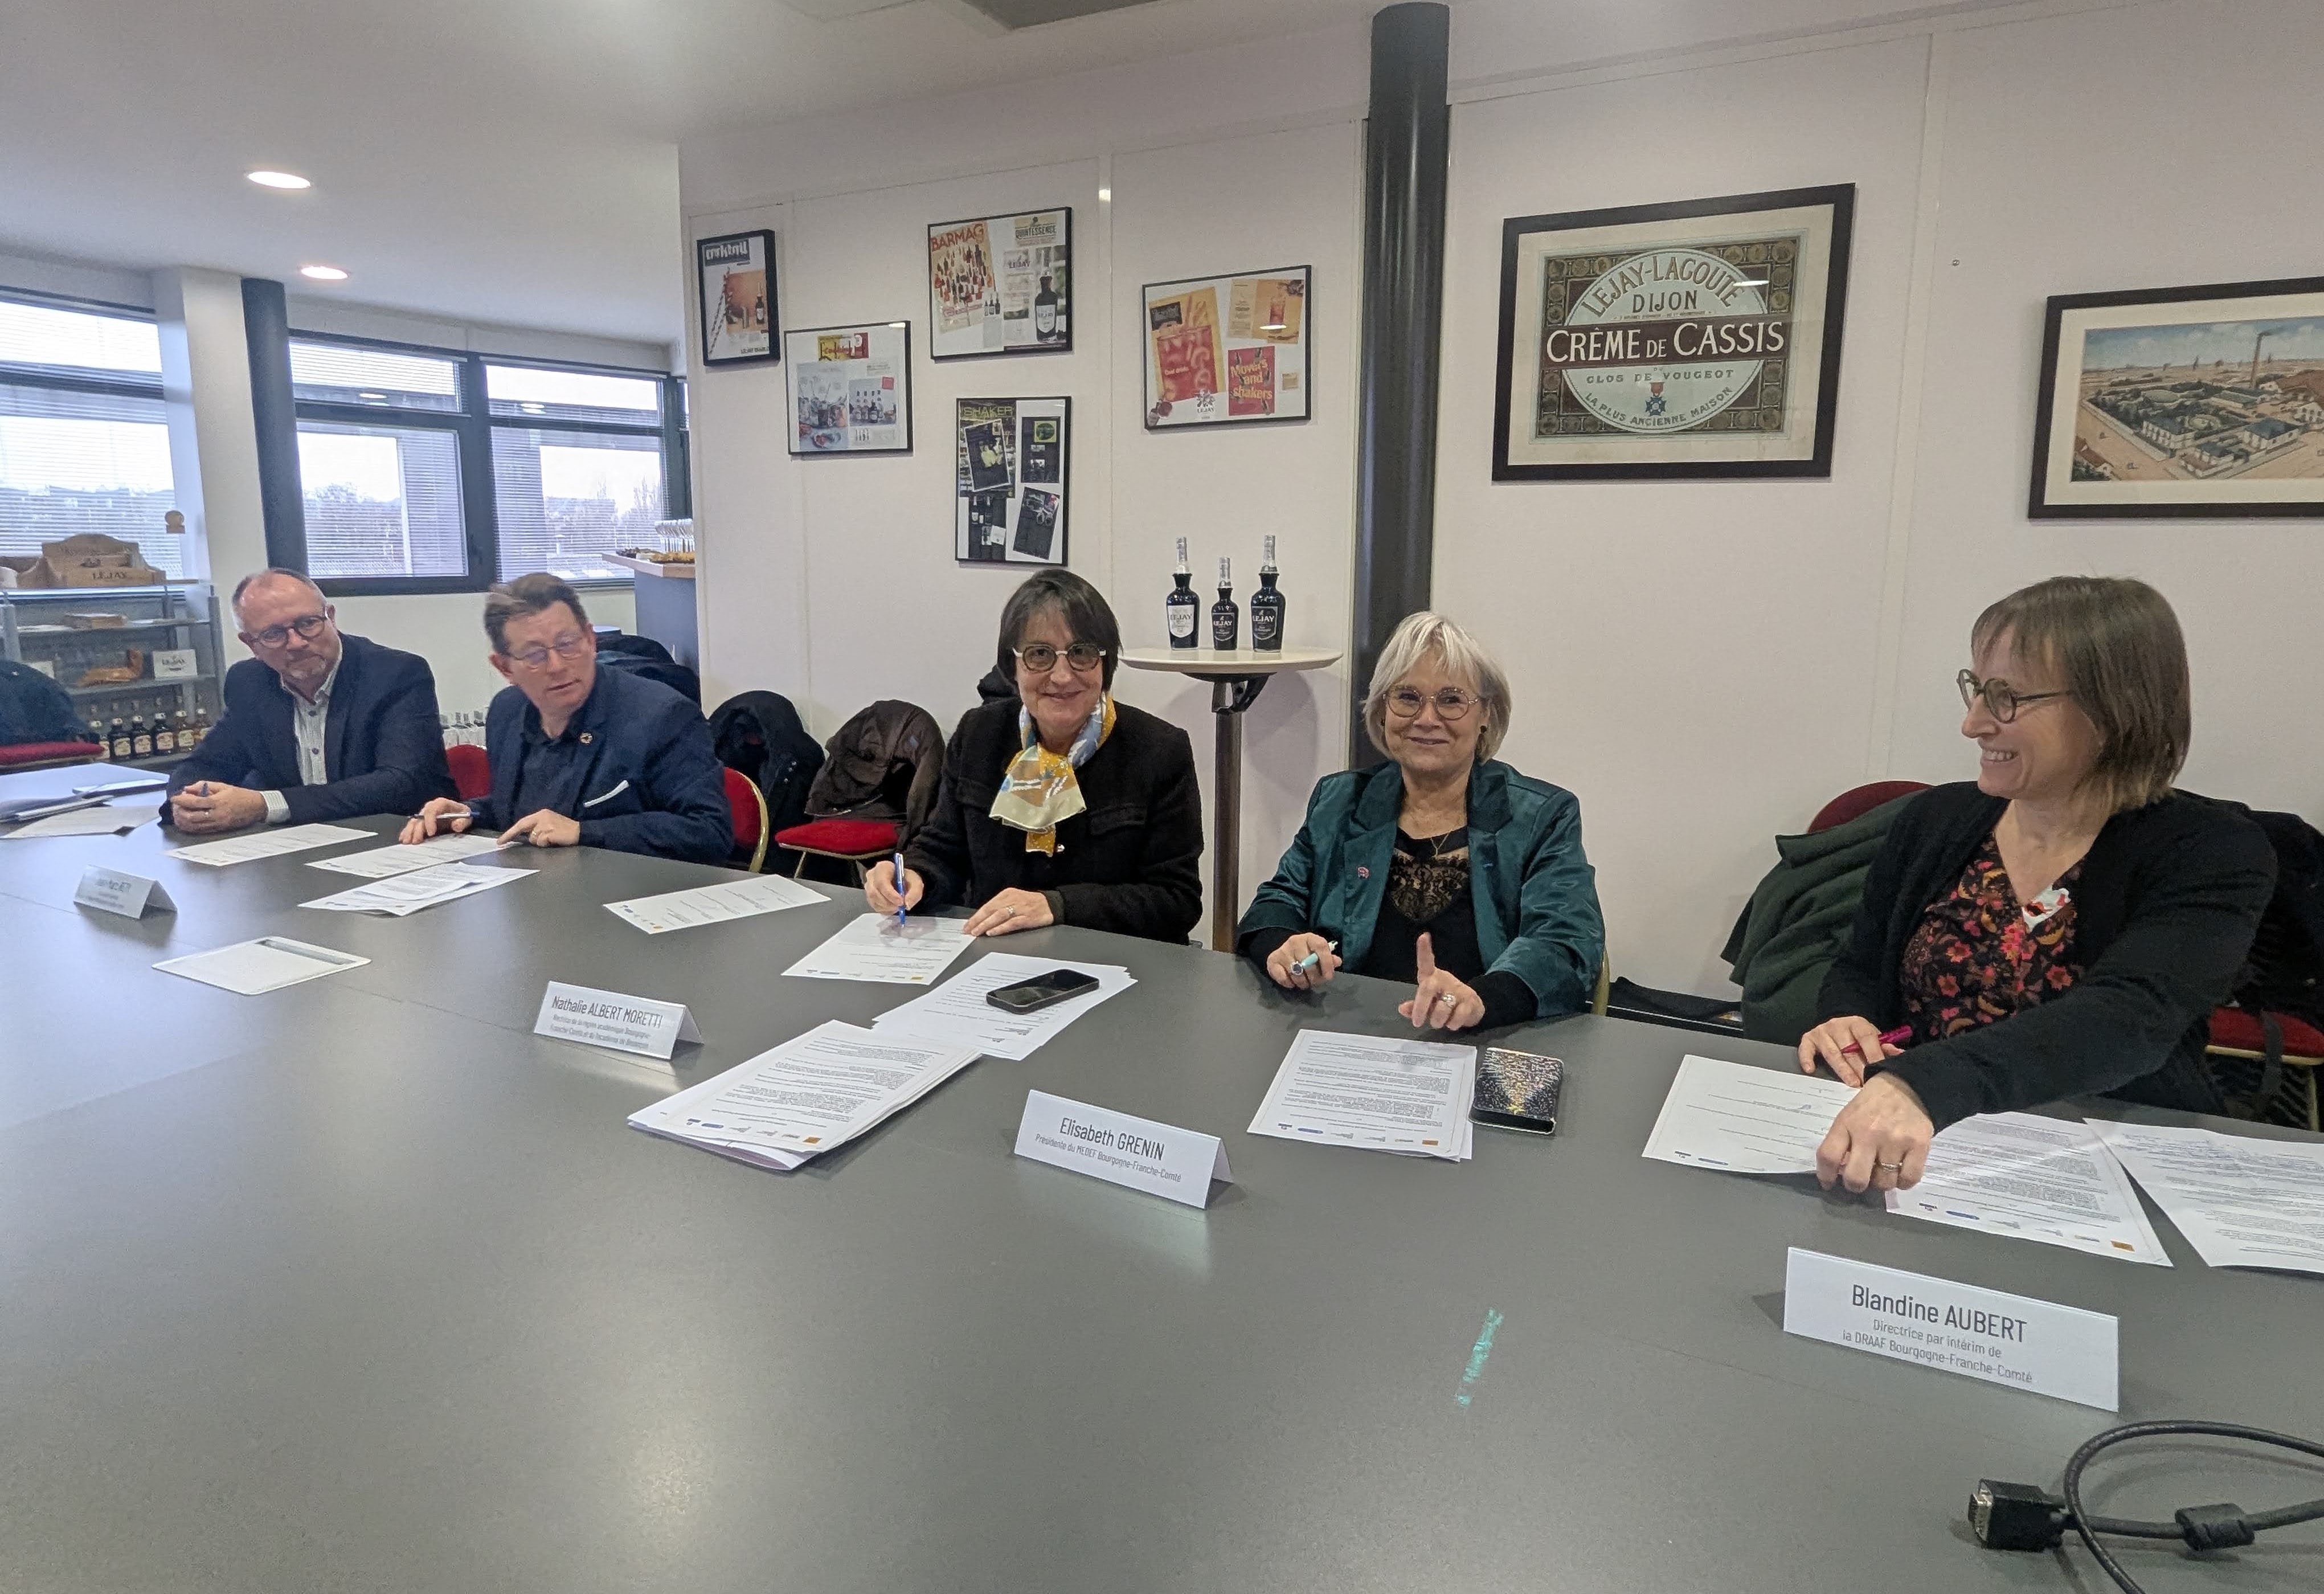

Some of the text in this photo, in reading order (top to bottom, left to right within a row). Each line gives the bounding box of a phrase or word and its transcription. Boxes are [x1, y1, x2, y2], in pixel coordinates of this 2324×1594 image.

[931, 223, 984, 252] BARMAG
[1632, 290, 1697, 313] DIJON
[1546, 321, 1784, 362] CRÊME DE CASSIS
[1243, 371, 1263, 384] and
[1586, 370, 1734, 384] CLOS DE VOUGEOT
[1233, 385, 1273, 400] shakers
[1584, 386, 1733, 426] LA PLUS ANCIENNE MAISON
[964, 406, 1013, 418] SHAKER
[551, 996, 663, 1028] Nathalie ALBERT MORETTI
[1059, 1118, 1165, 1160] Elisabeth GRENIN
[1067, 1143, 1075, 1152] du
[1076, 1145, 1097, 1158] MEDEF
[1852, 1284, 2027, 1342] Blandine AUBERT
[1873, 1319, 2001, 1358] Directrice par intérim de
[1843, 1329, 2032, 1383] la DRAAF Bourgogne-Franche-Comté
